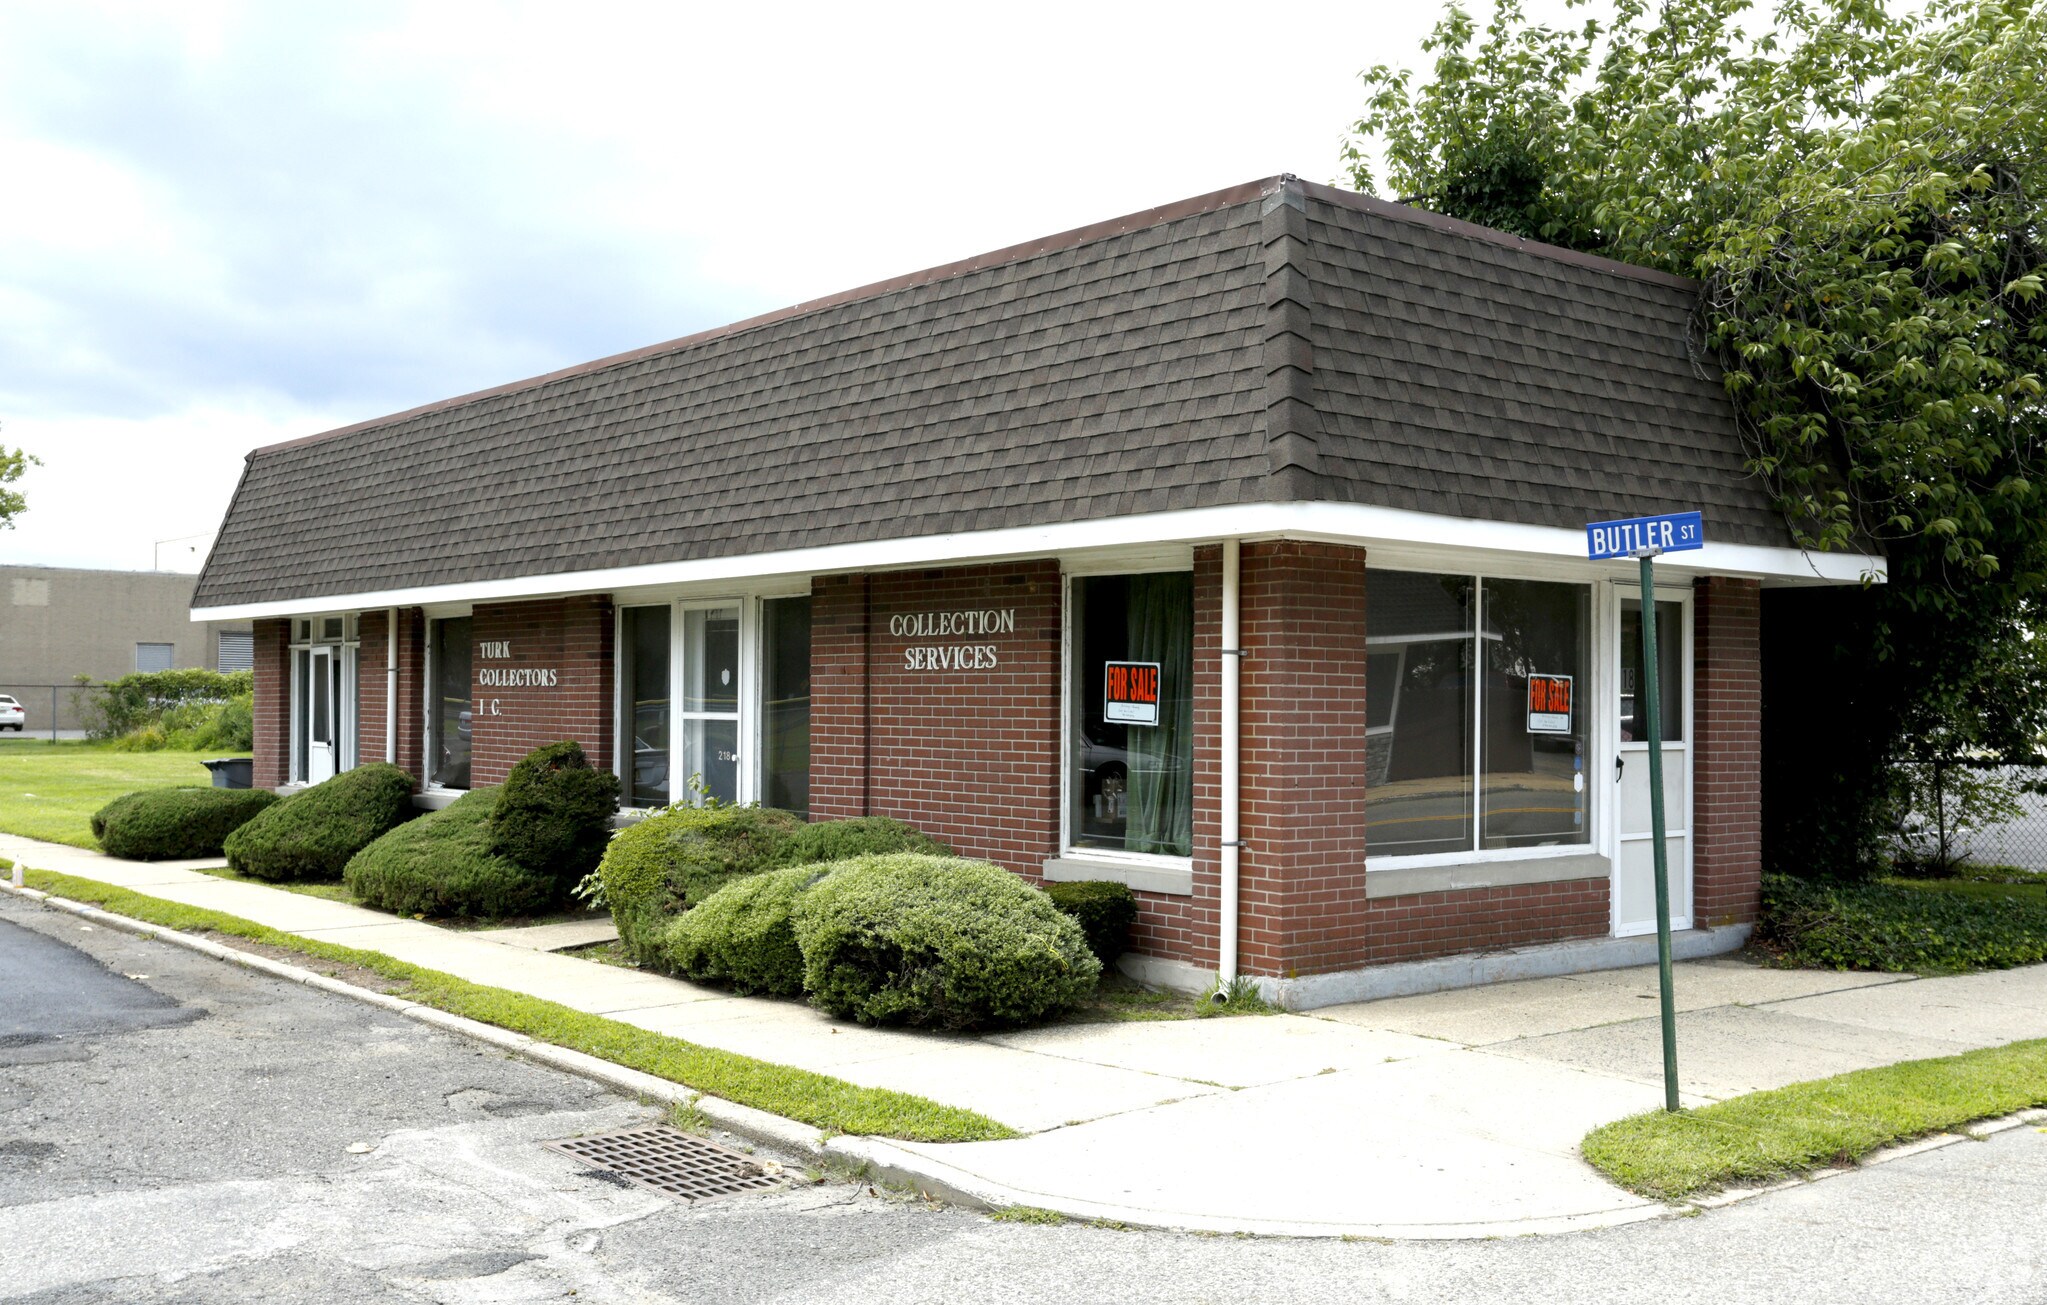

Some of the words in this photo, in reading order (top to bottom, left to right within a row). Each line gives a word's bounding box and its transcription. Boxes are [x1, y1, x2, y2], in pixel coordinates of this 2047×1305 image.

[1593, 520, 1674, 554] BUTLER
[1681, 524, 1695, 540] ST
[889, 608, 1015, 637] COLLECTION
[479, 640, 511, 659] TURK
[904, 645, 998, 671] SERVICES
[478, 668, 557, 687] COLLECTORS
[1107, 666, 1127, 700] FOR
[1130, 667, 1157, 702] SALE
[1530, 678, 1546, 712] FOR
[1548, 679, 1569, 712] SALE
[718, 750, 731, 761] 218
